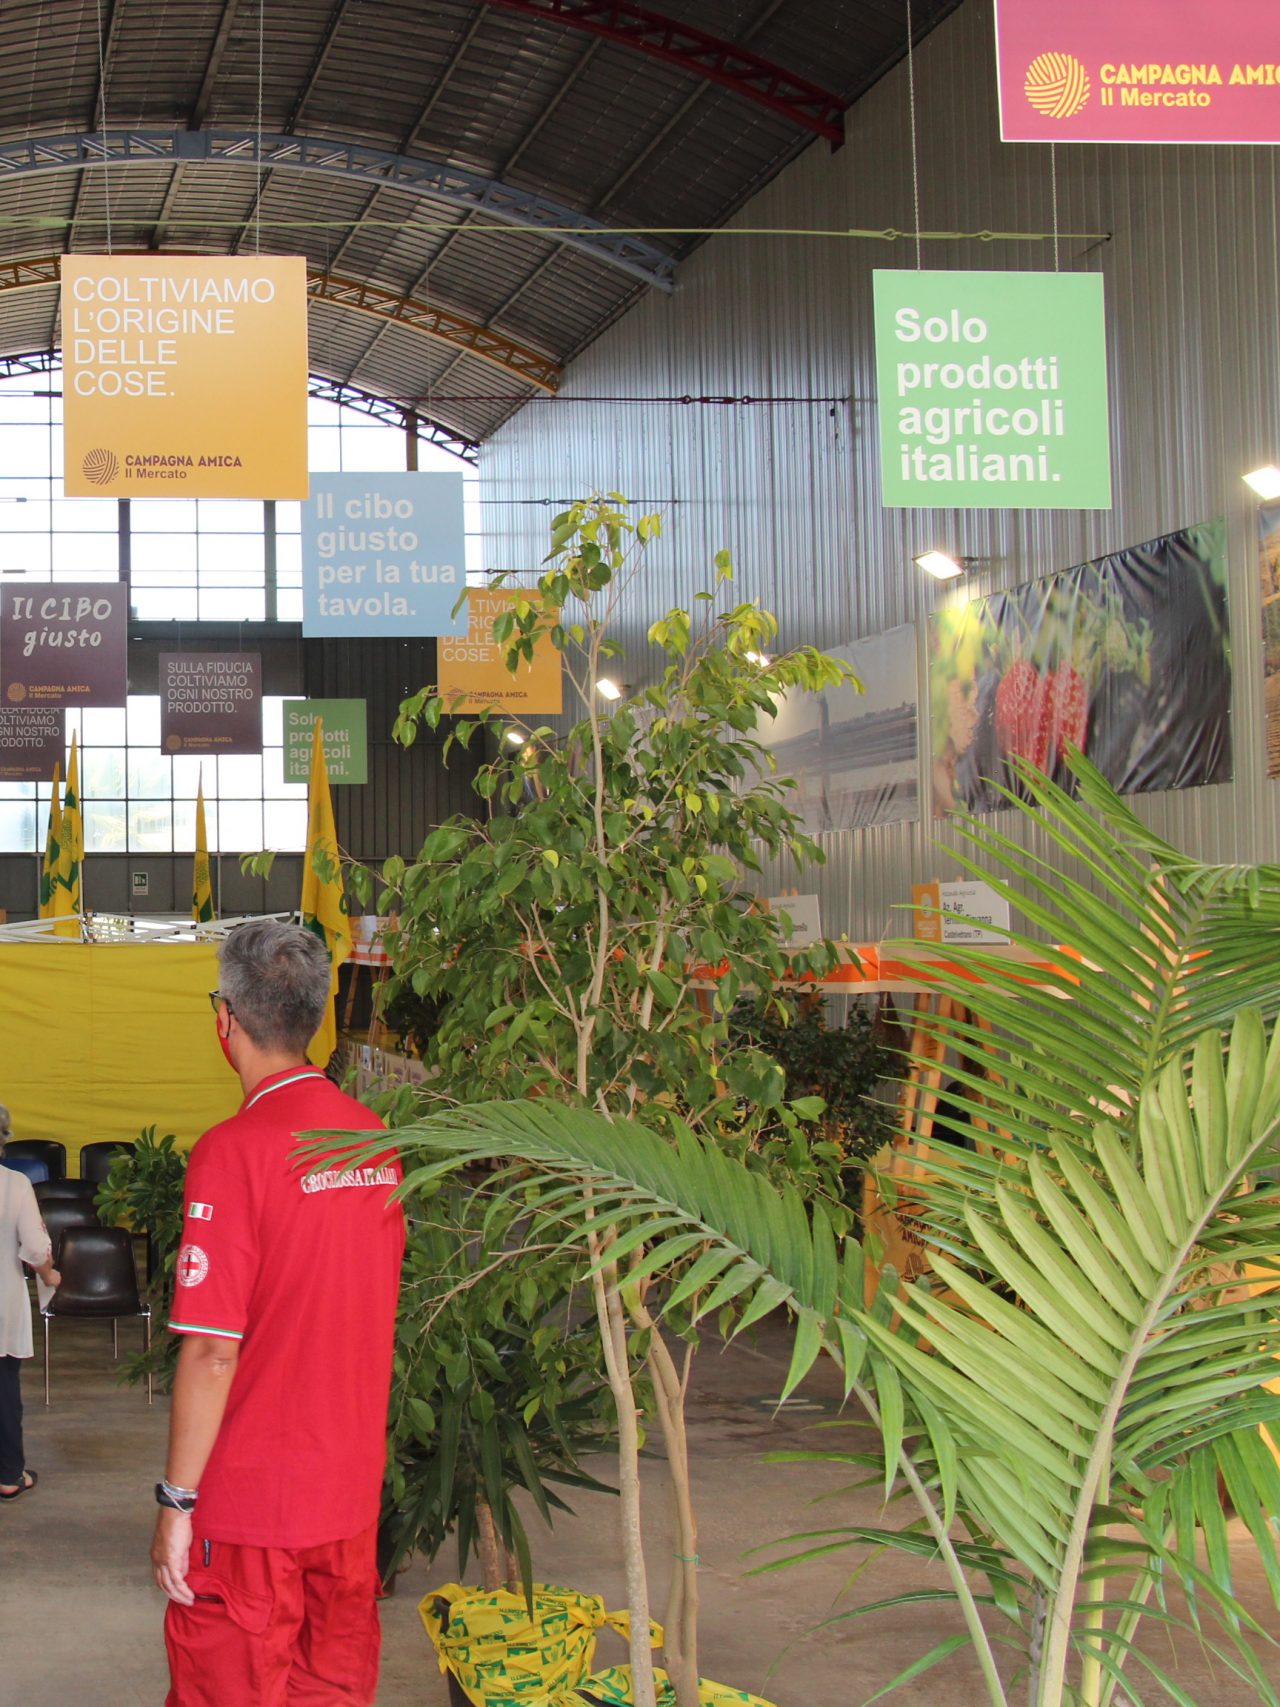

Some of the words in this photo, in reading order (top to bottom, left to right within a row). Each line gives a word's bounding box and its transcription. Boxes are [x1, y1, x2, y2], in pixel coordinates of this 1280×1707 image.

[1100, 64, 1223, 85] CAMPAGNA
[1228, 64, 1280, 85] AMI
[1100, 87, 1113, 107] Il
[1120, 87, 1211, 107] Mercato
[73, 276, 275, 303] COLTIVIAMO
[74, 308, 236, 334] L'ORIGINE
[894, 307, 988, 343] Solo
[74, 339, 178, 365] DELLE
[73, 371, 176, 397] COSE.
[896, 355, 1059, 397] prodotti
[898, 399, 1064, 445] agricoli
[125, 455, 194, 467] CAMPAGNA
[198, 456, 242, 468] AMICA
[125, 468, 132, 479] Il
[137, 468, 187, 479] Mercato
[900, 444, 1062, 482] italiani.
[316, 493, 334, 519] Il
[345, 493, 414, 519] cibo
[316, 525, 419, 558] giusto
[318, 564, 366, 589] per
[376, 559, 400, 584] la
[409, 560, 456, 584] tua
[12, 597, 33, 621] Il
[40, 596, 112, 622] CIBO
[317, 592, 417, 616] tavola.
[23, 626, 102, 657] giusto
[168, 662, 205, 673] SULLA
[207, 662, 253, 673] FIDUCIA
[442, 648, 495, 662] COSE.
[167, 675, 248, 687] COLTIVIAMO
[167, 688, 198, 700] OGNI
[202, 688, 253, 700] NOSTRO
[167, 701, 237, 713] PRODOTTO.
[17, 726, 60, 737] NOSTRO
